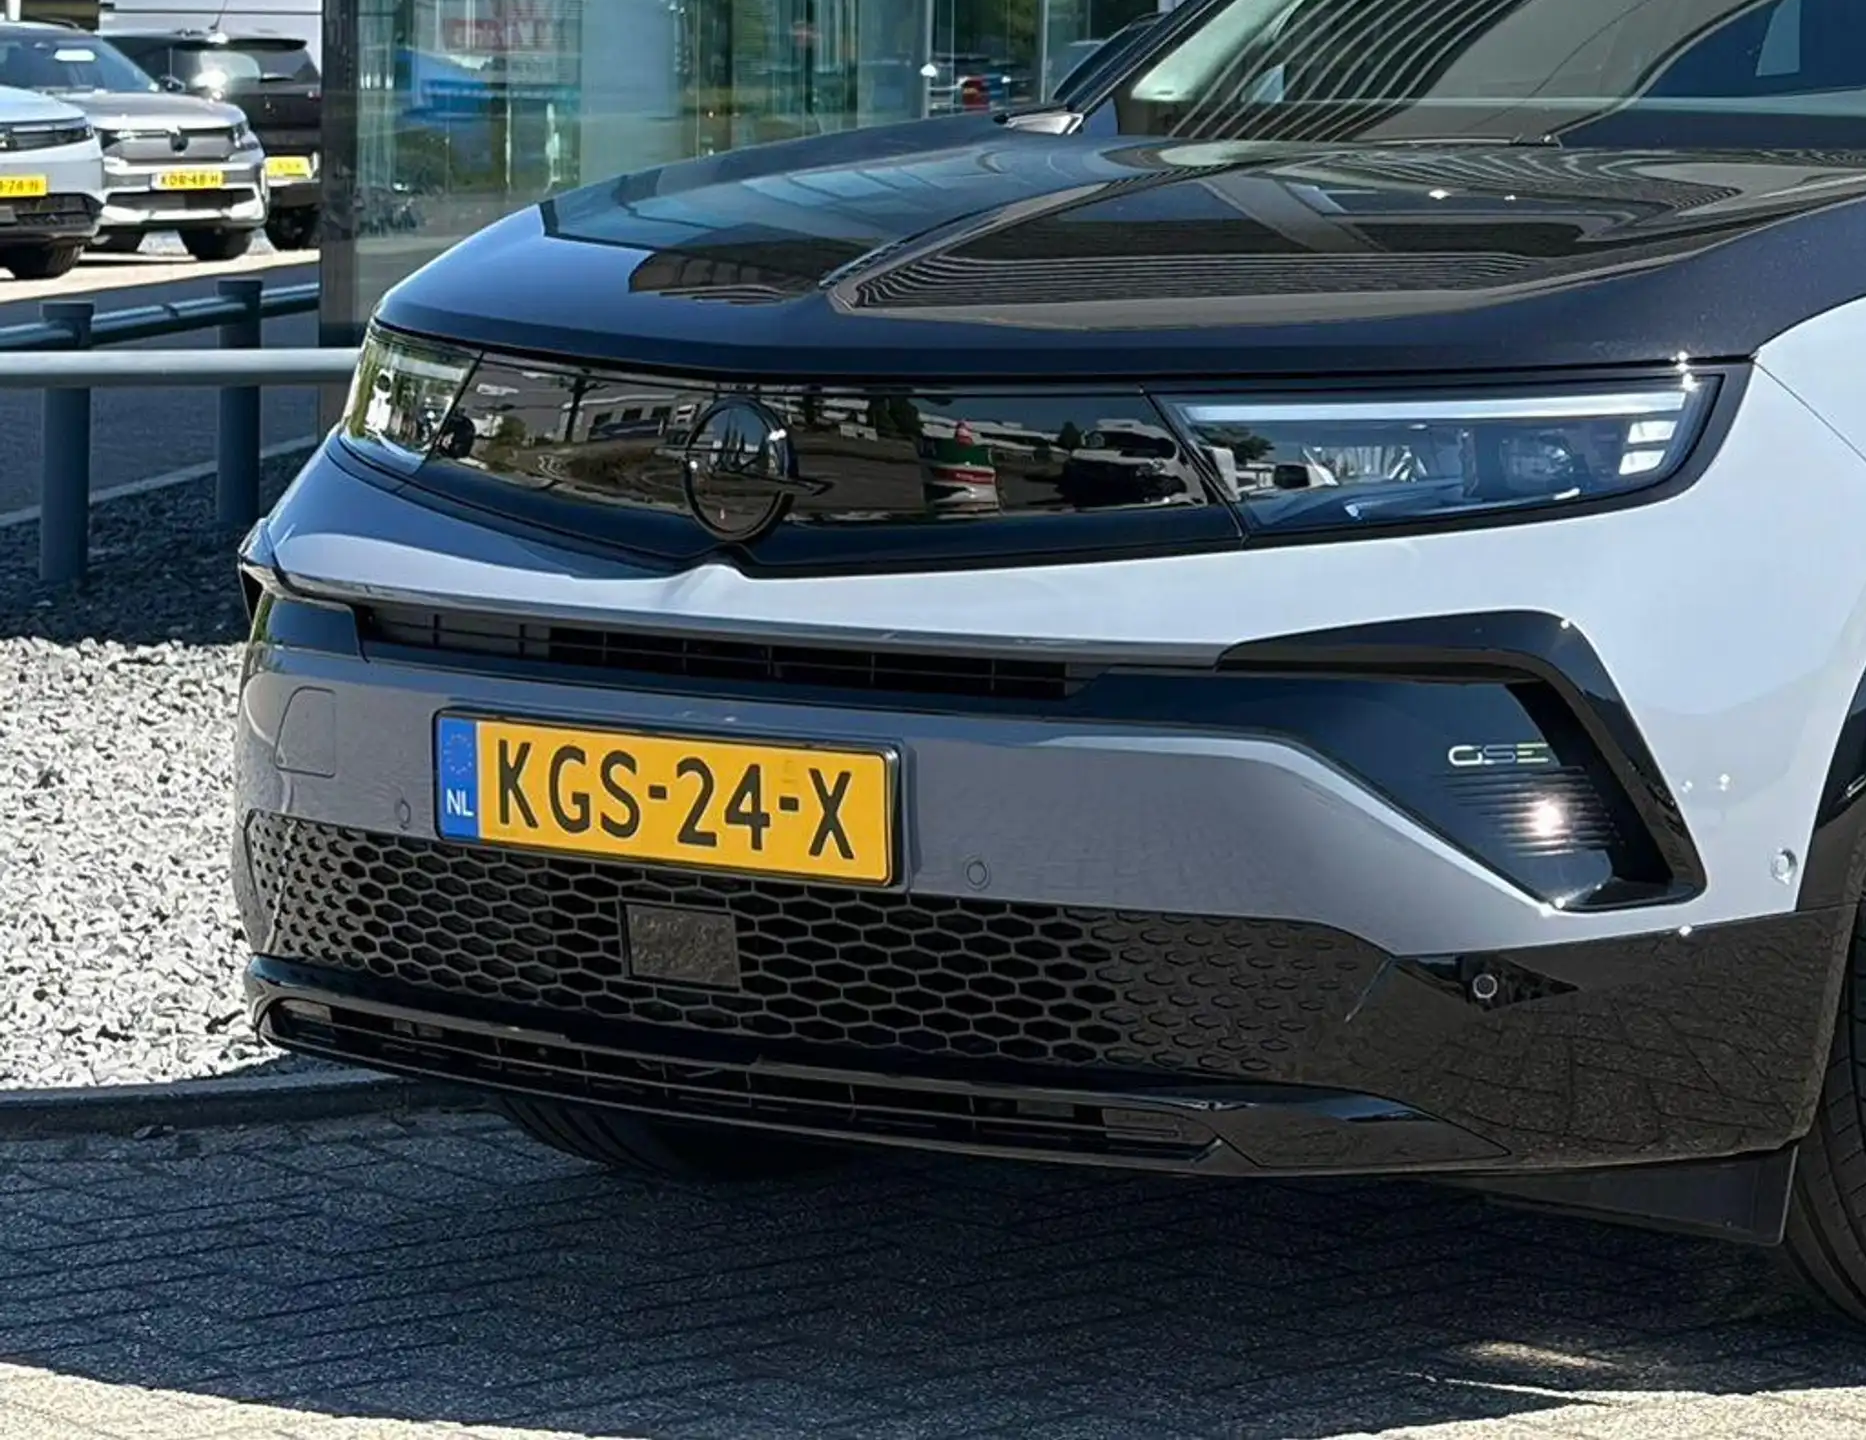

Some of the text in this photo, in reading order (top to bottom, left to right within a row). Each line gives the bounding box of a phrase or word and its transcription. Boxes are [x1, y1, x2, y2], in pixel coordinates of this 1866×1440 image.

[1448, 742, 1549, 767] GSE
[446, 789, 474, 818] NL
[498, 739, 855, 860] KGS-24-X
